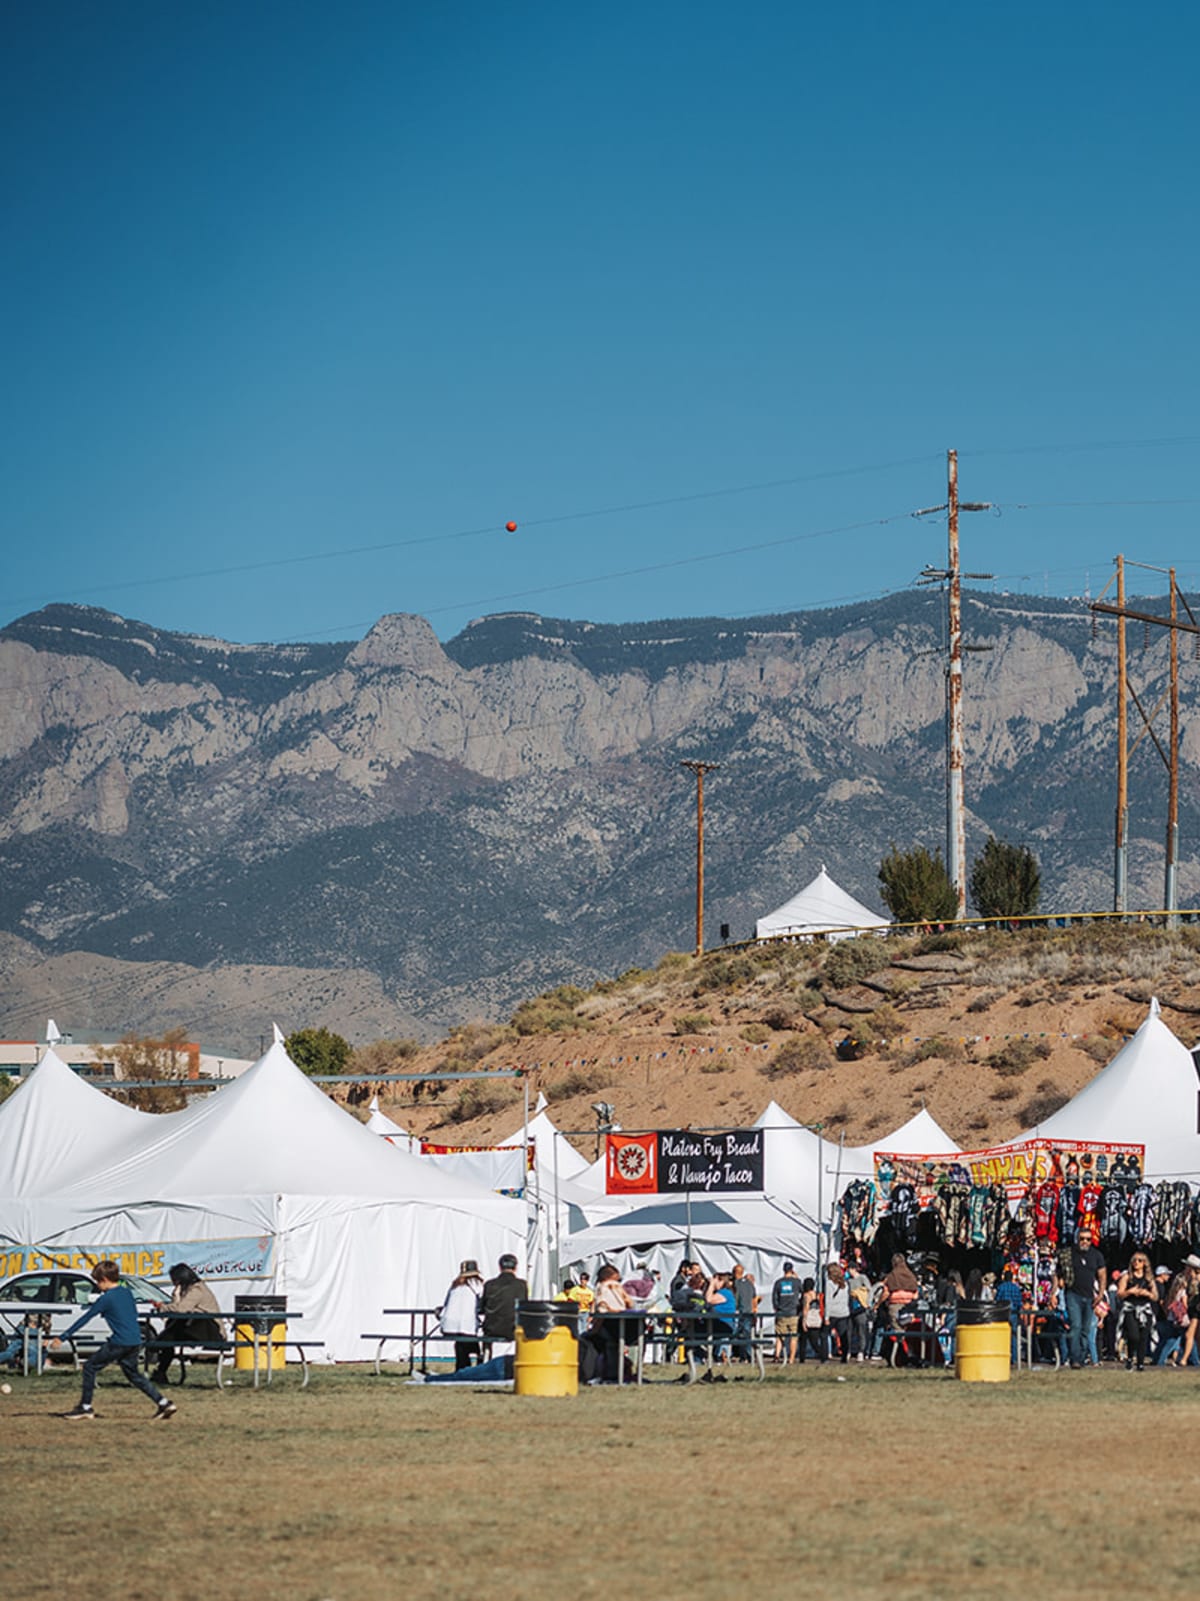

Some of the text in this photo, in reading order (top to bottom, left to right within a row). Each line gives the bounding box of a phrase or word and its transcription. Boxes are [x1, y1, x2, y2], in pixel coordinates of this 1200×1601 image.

[704, 1137, 722, 1163] Fry
[726, 1135, 760, 1156] Bread
[668, 1163, 753, 1190] & Navajo Tacos
